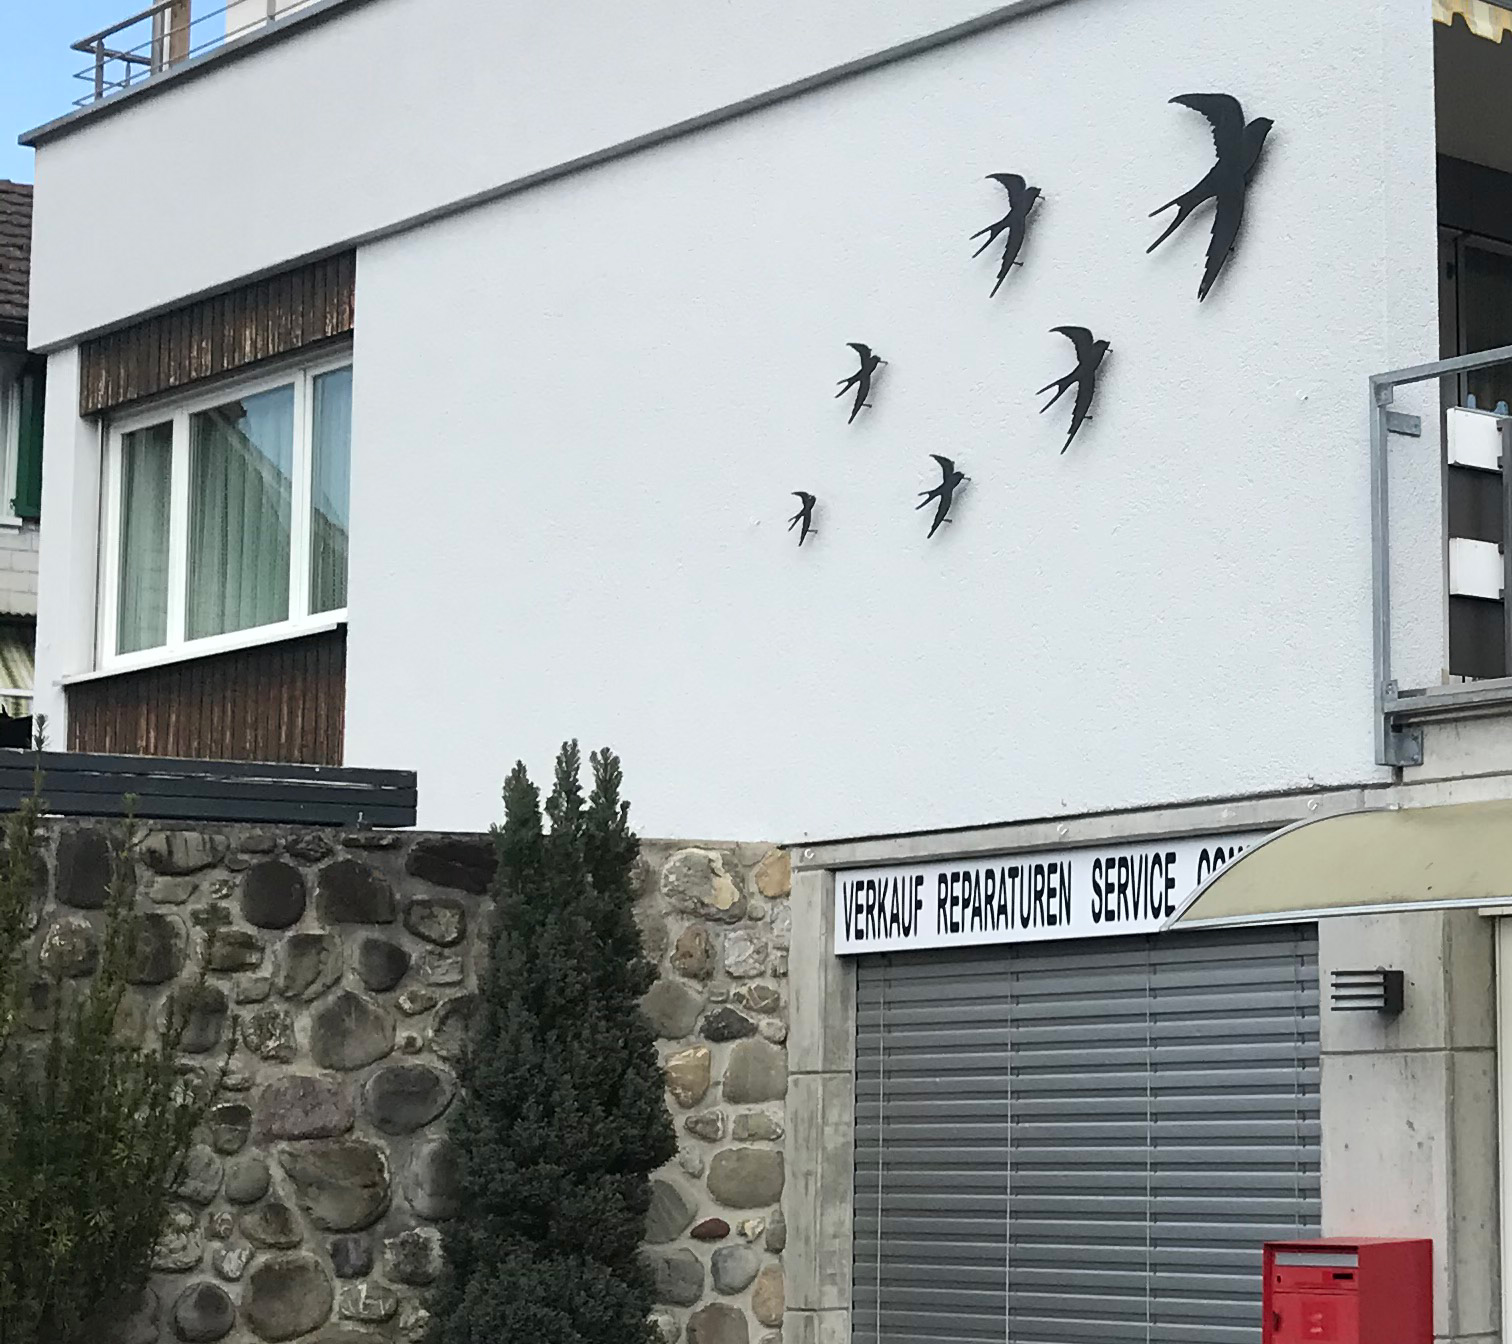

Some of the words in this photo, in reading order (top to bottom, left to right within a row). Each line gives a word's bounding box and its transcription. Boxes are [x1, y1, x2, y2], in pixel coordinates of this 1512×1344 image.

[844, 875, 924, 942] VERKAUF
[937, 861, 1072, 935] REPARATUREN
[1092, 852, 1177, 923] SERVICE
